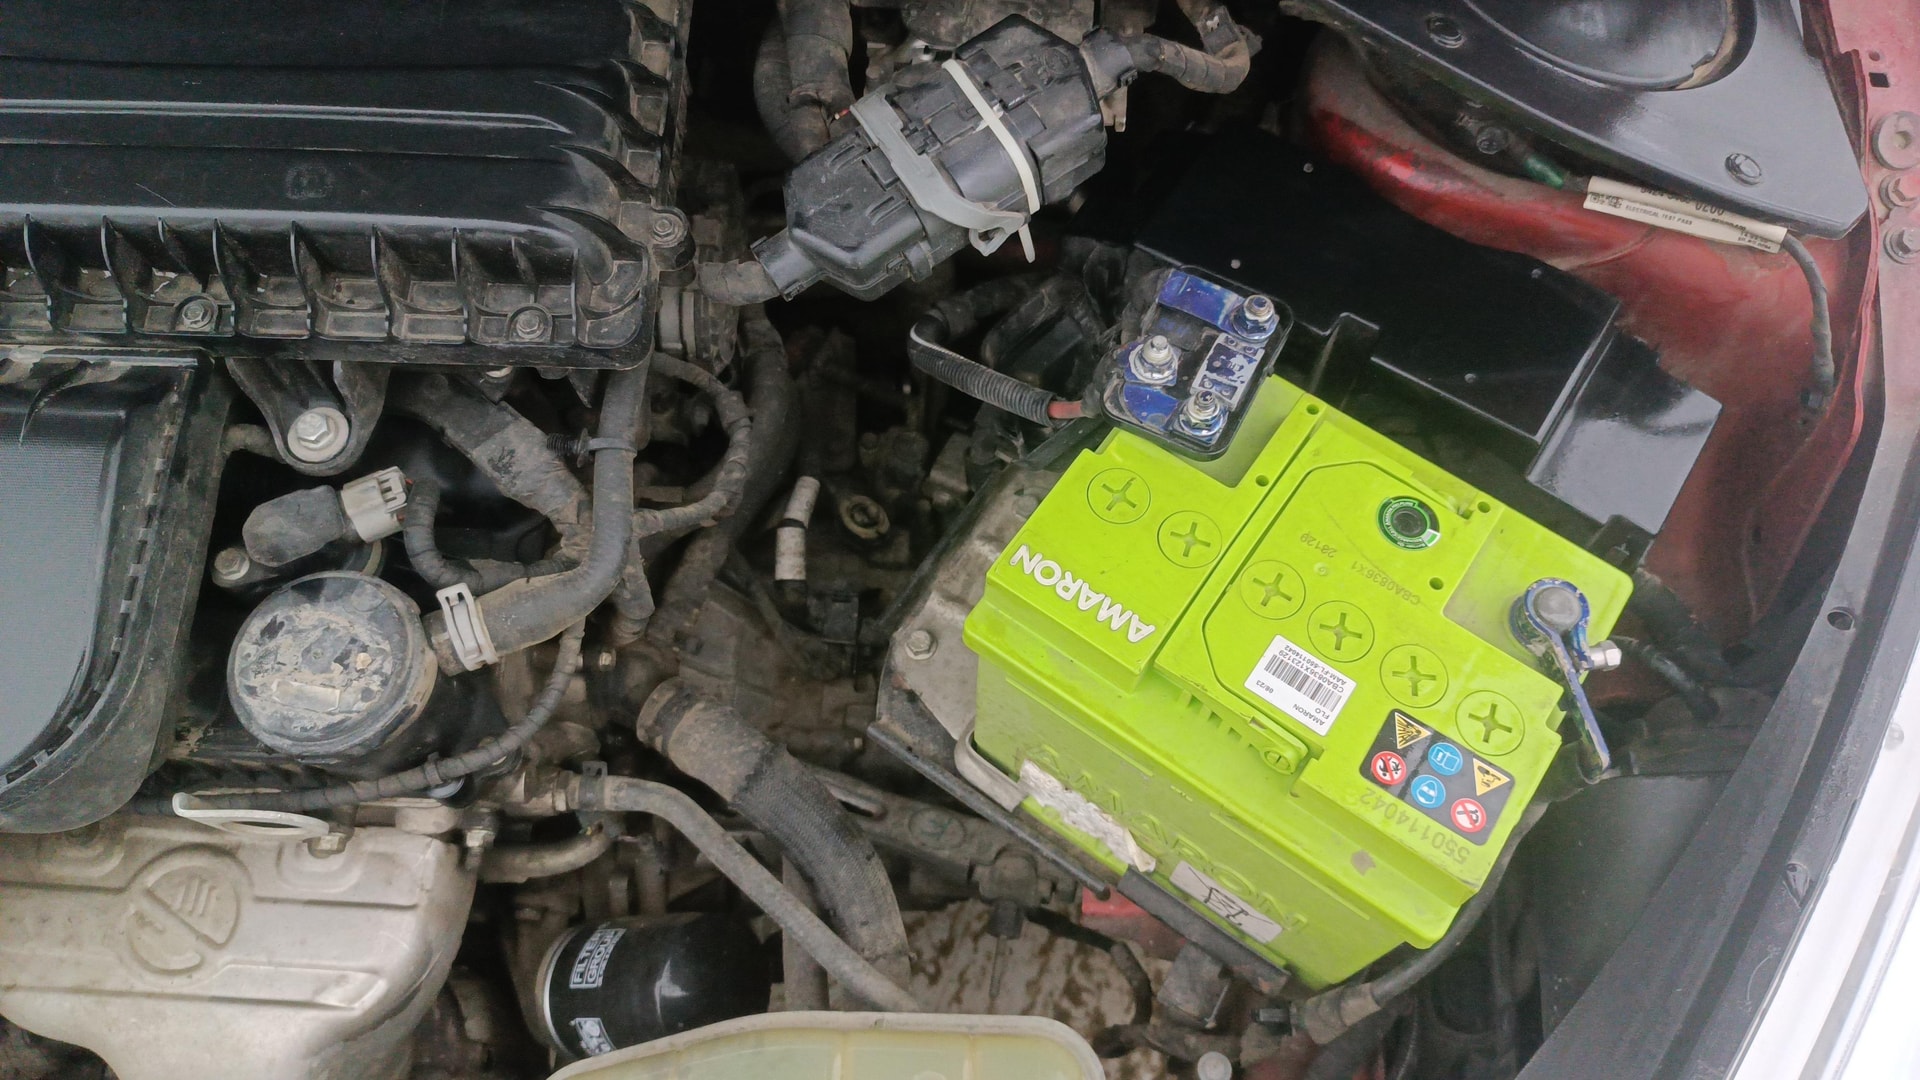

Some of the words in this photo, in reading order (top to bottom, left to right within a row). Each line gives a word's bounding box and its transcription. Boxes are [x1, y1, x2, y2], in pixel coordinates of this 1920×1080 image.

[1010, 544, 1156, 643] AMARON
[1292, 703, 1325, 726] AMARON
[1315, 707, 1330, 720] FLO
[1360, 787, 1471, 865] 550114042
